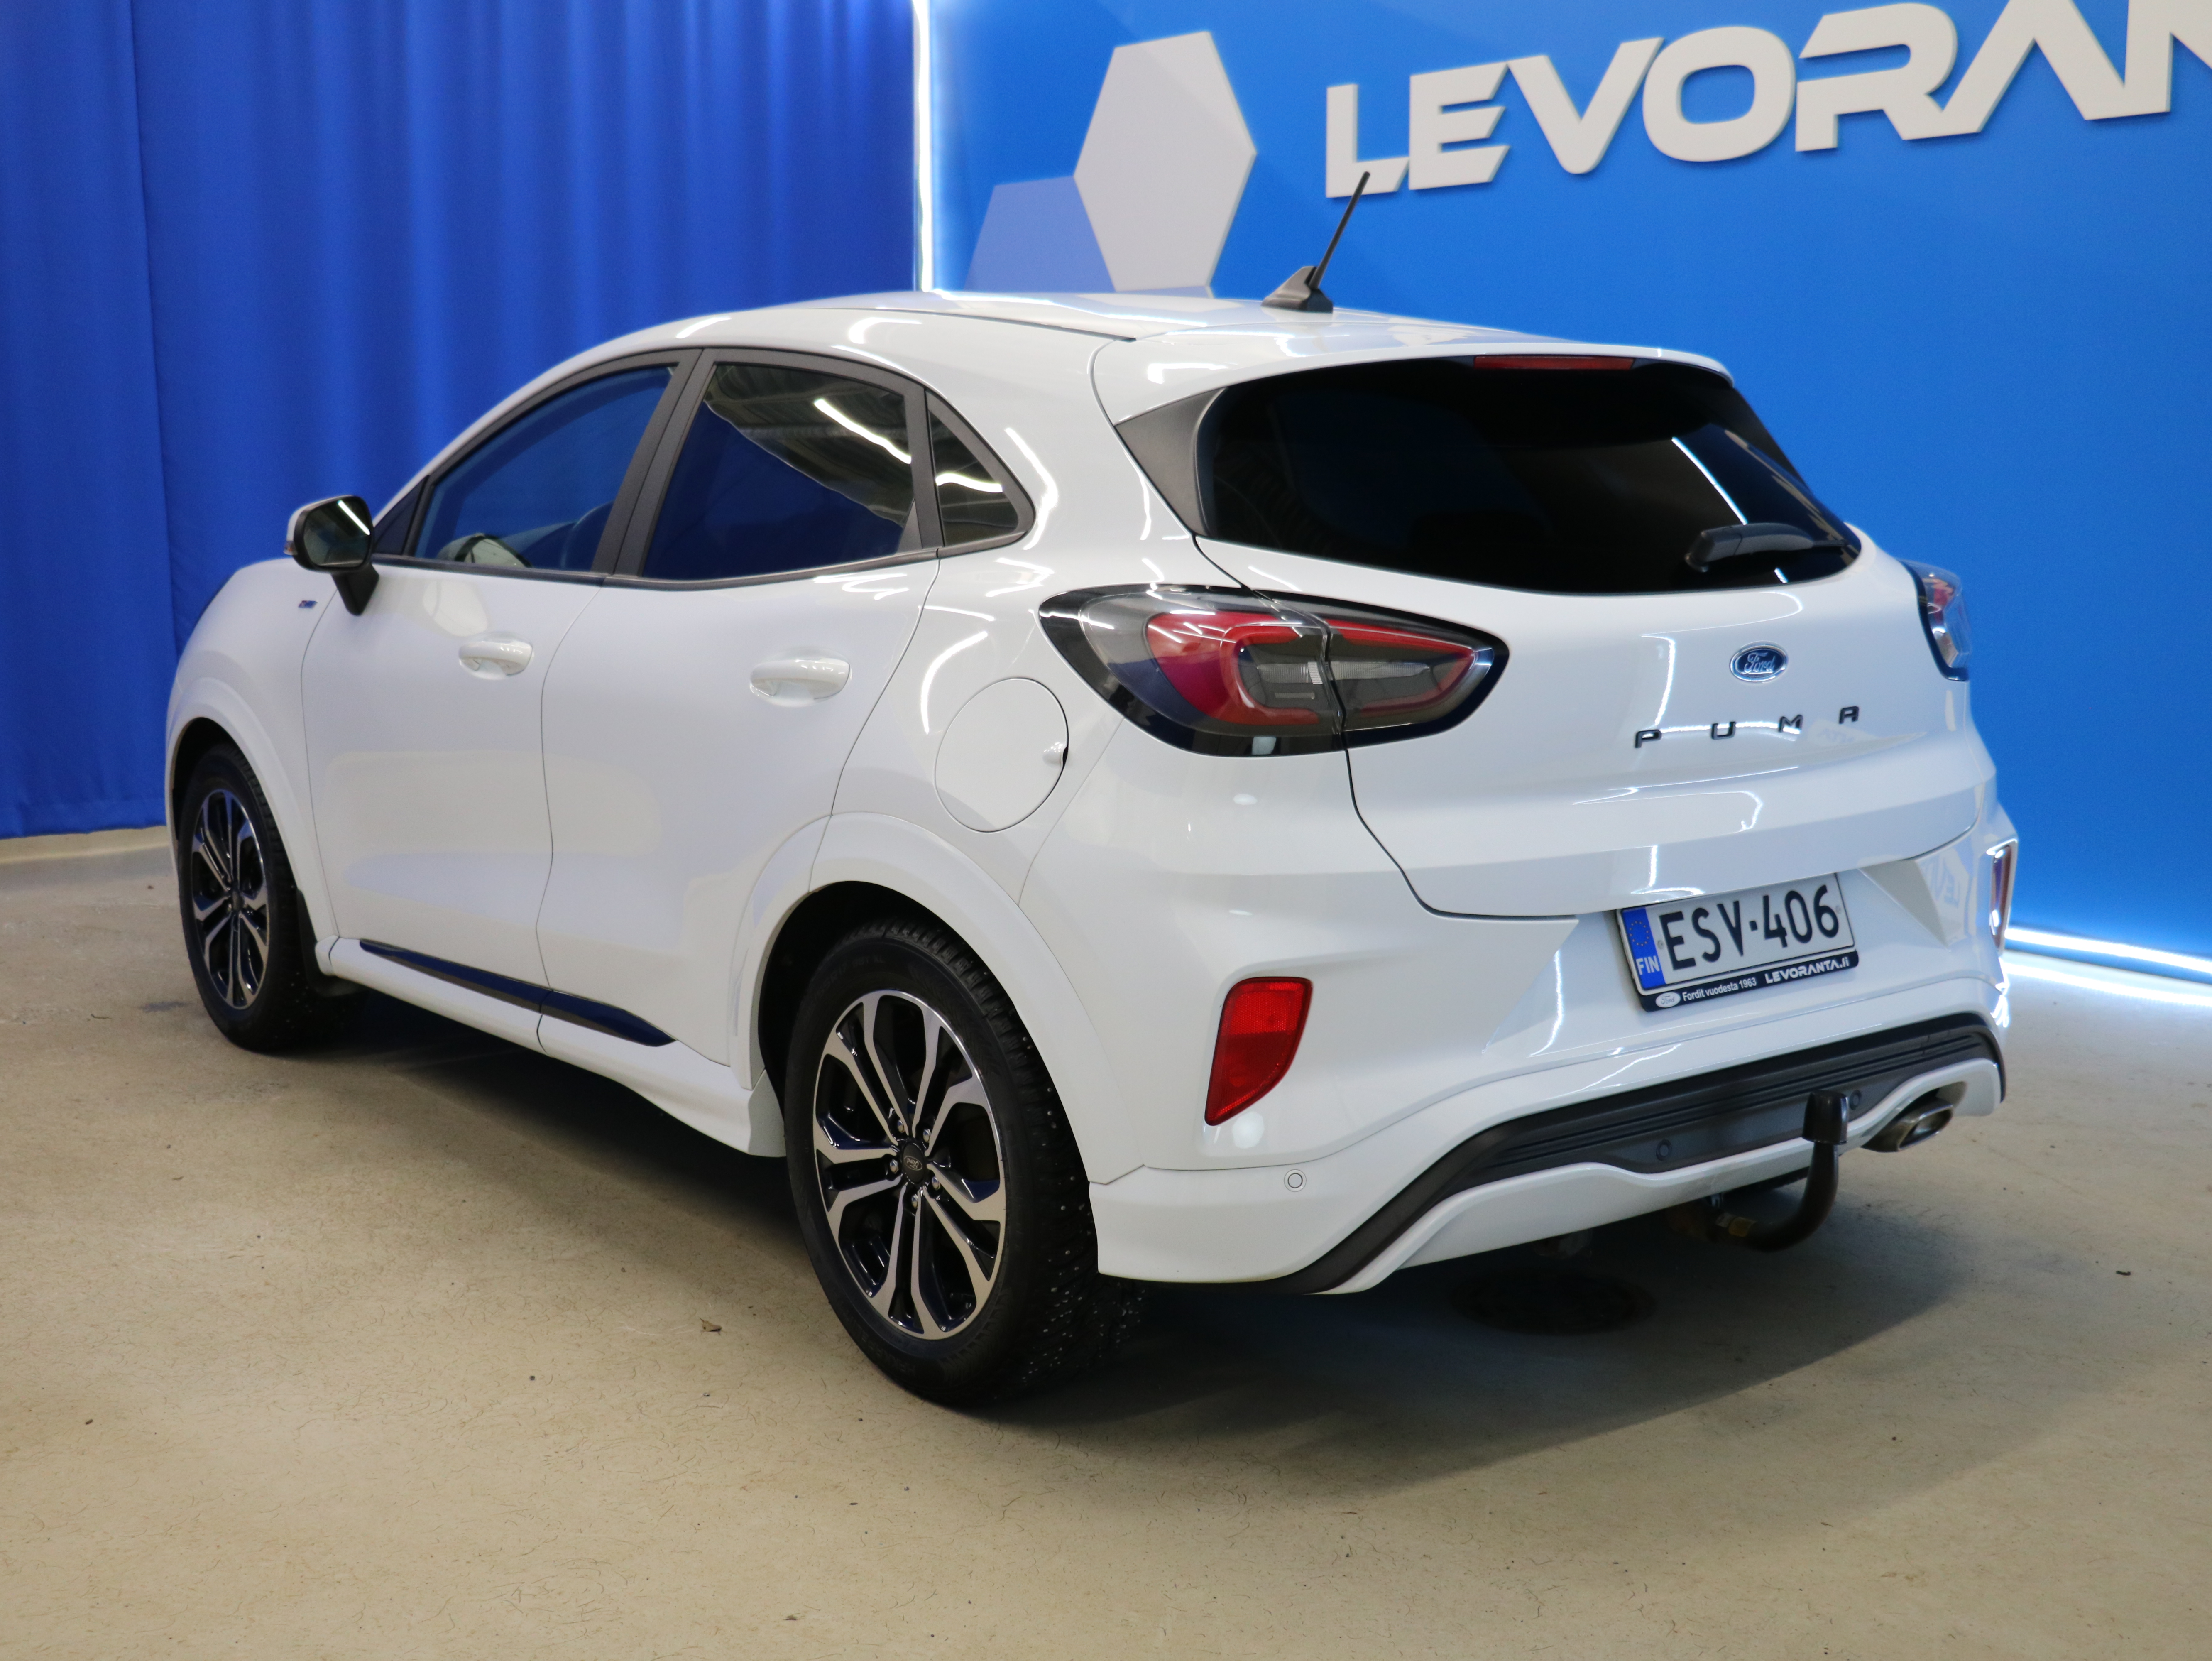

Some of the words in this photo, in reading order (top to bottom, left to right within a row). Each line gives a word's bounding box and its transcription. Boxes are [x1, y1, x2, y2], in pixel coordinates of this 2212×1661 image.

[1635, 706, 1859, 749] PUMA
[1635, 955, 1660, 975] FIN
[1764, 956, 1850, 984] LEVORANTA.fi
[1682, 989, 1705, 1002] Fordit
[1705, 982, 1739, 997] vuodesta
[1739, 977, 1757, 989] 1963
